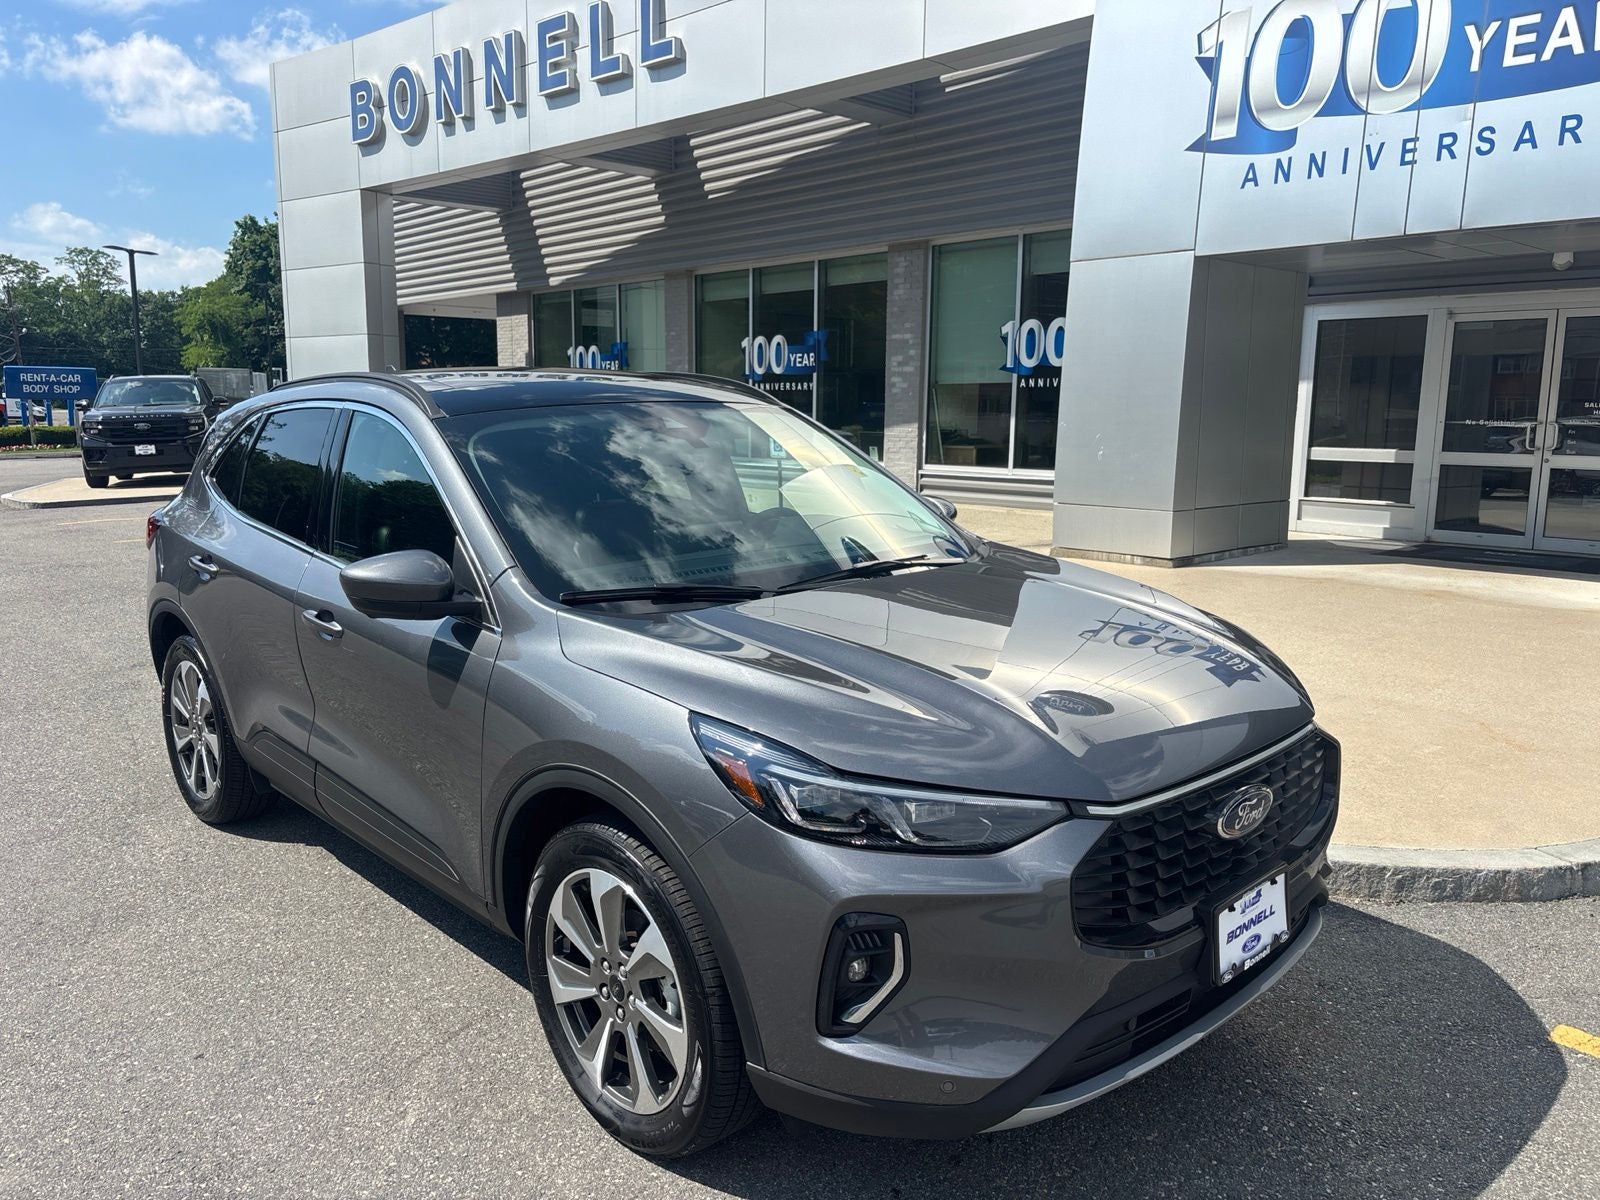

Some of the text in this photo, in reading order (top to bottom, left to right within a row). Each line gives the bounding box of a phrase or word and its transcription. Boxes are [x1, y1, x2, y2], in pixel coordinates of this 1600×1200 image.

[350, 0, 679, 144] BONNELL
[1197, 0, 1600, 141] 100 YEA
[1240, 113, 1583, 190] ANNIVERSAR
[567, 345, 601, 369] 100
[741, 334, 815, 375] 100 YEAR
[1001, 317, 1066, 368] 100
[20, 373, 81, 383] RENT-A-CAR
[23, 385, 81, 393] BODY SHOP
[755, 382, 813, 391] ANNIVERSARY
[1020, 378, 1059, 388] ANNIV
[1234, 798, 1265, 830] Ford
[1226, 904, 1276, 945] BONNELL
